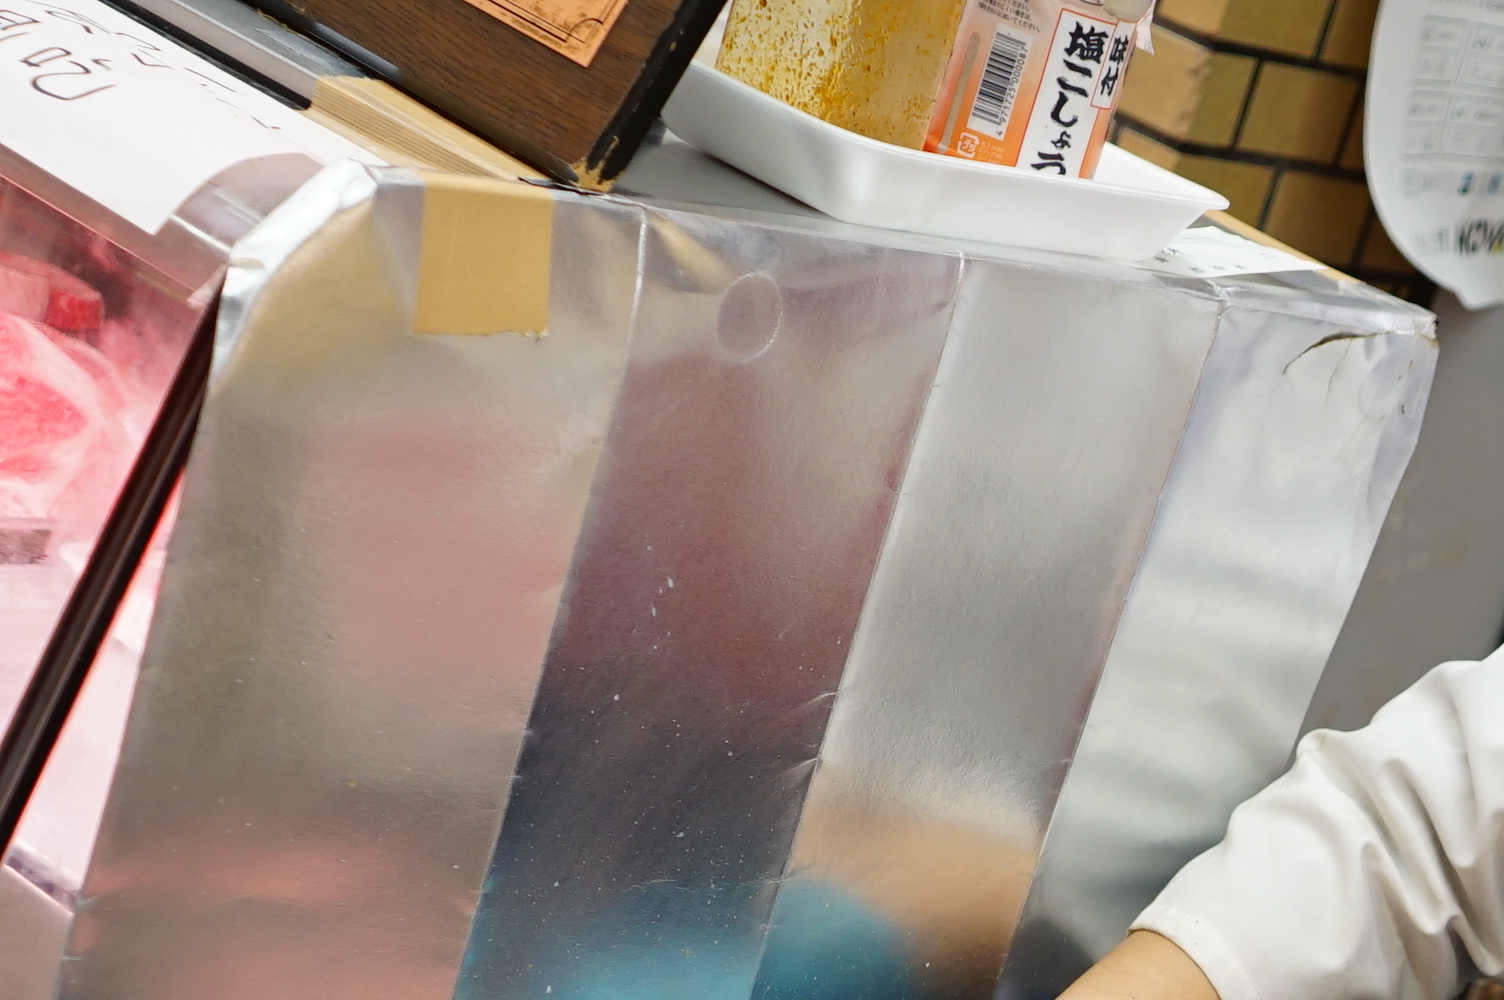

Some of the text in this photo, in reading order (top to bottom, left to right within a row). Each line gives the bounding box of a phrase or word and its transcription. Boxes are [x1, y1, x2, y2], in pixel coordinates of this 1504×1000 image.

[1030, 21, 1109, 176] 塩こしょう
[1100, 35, 1129, 97] 味付
